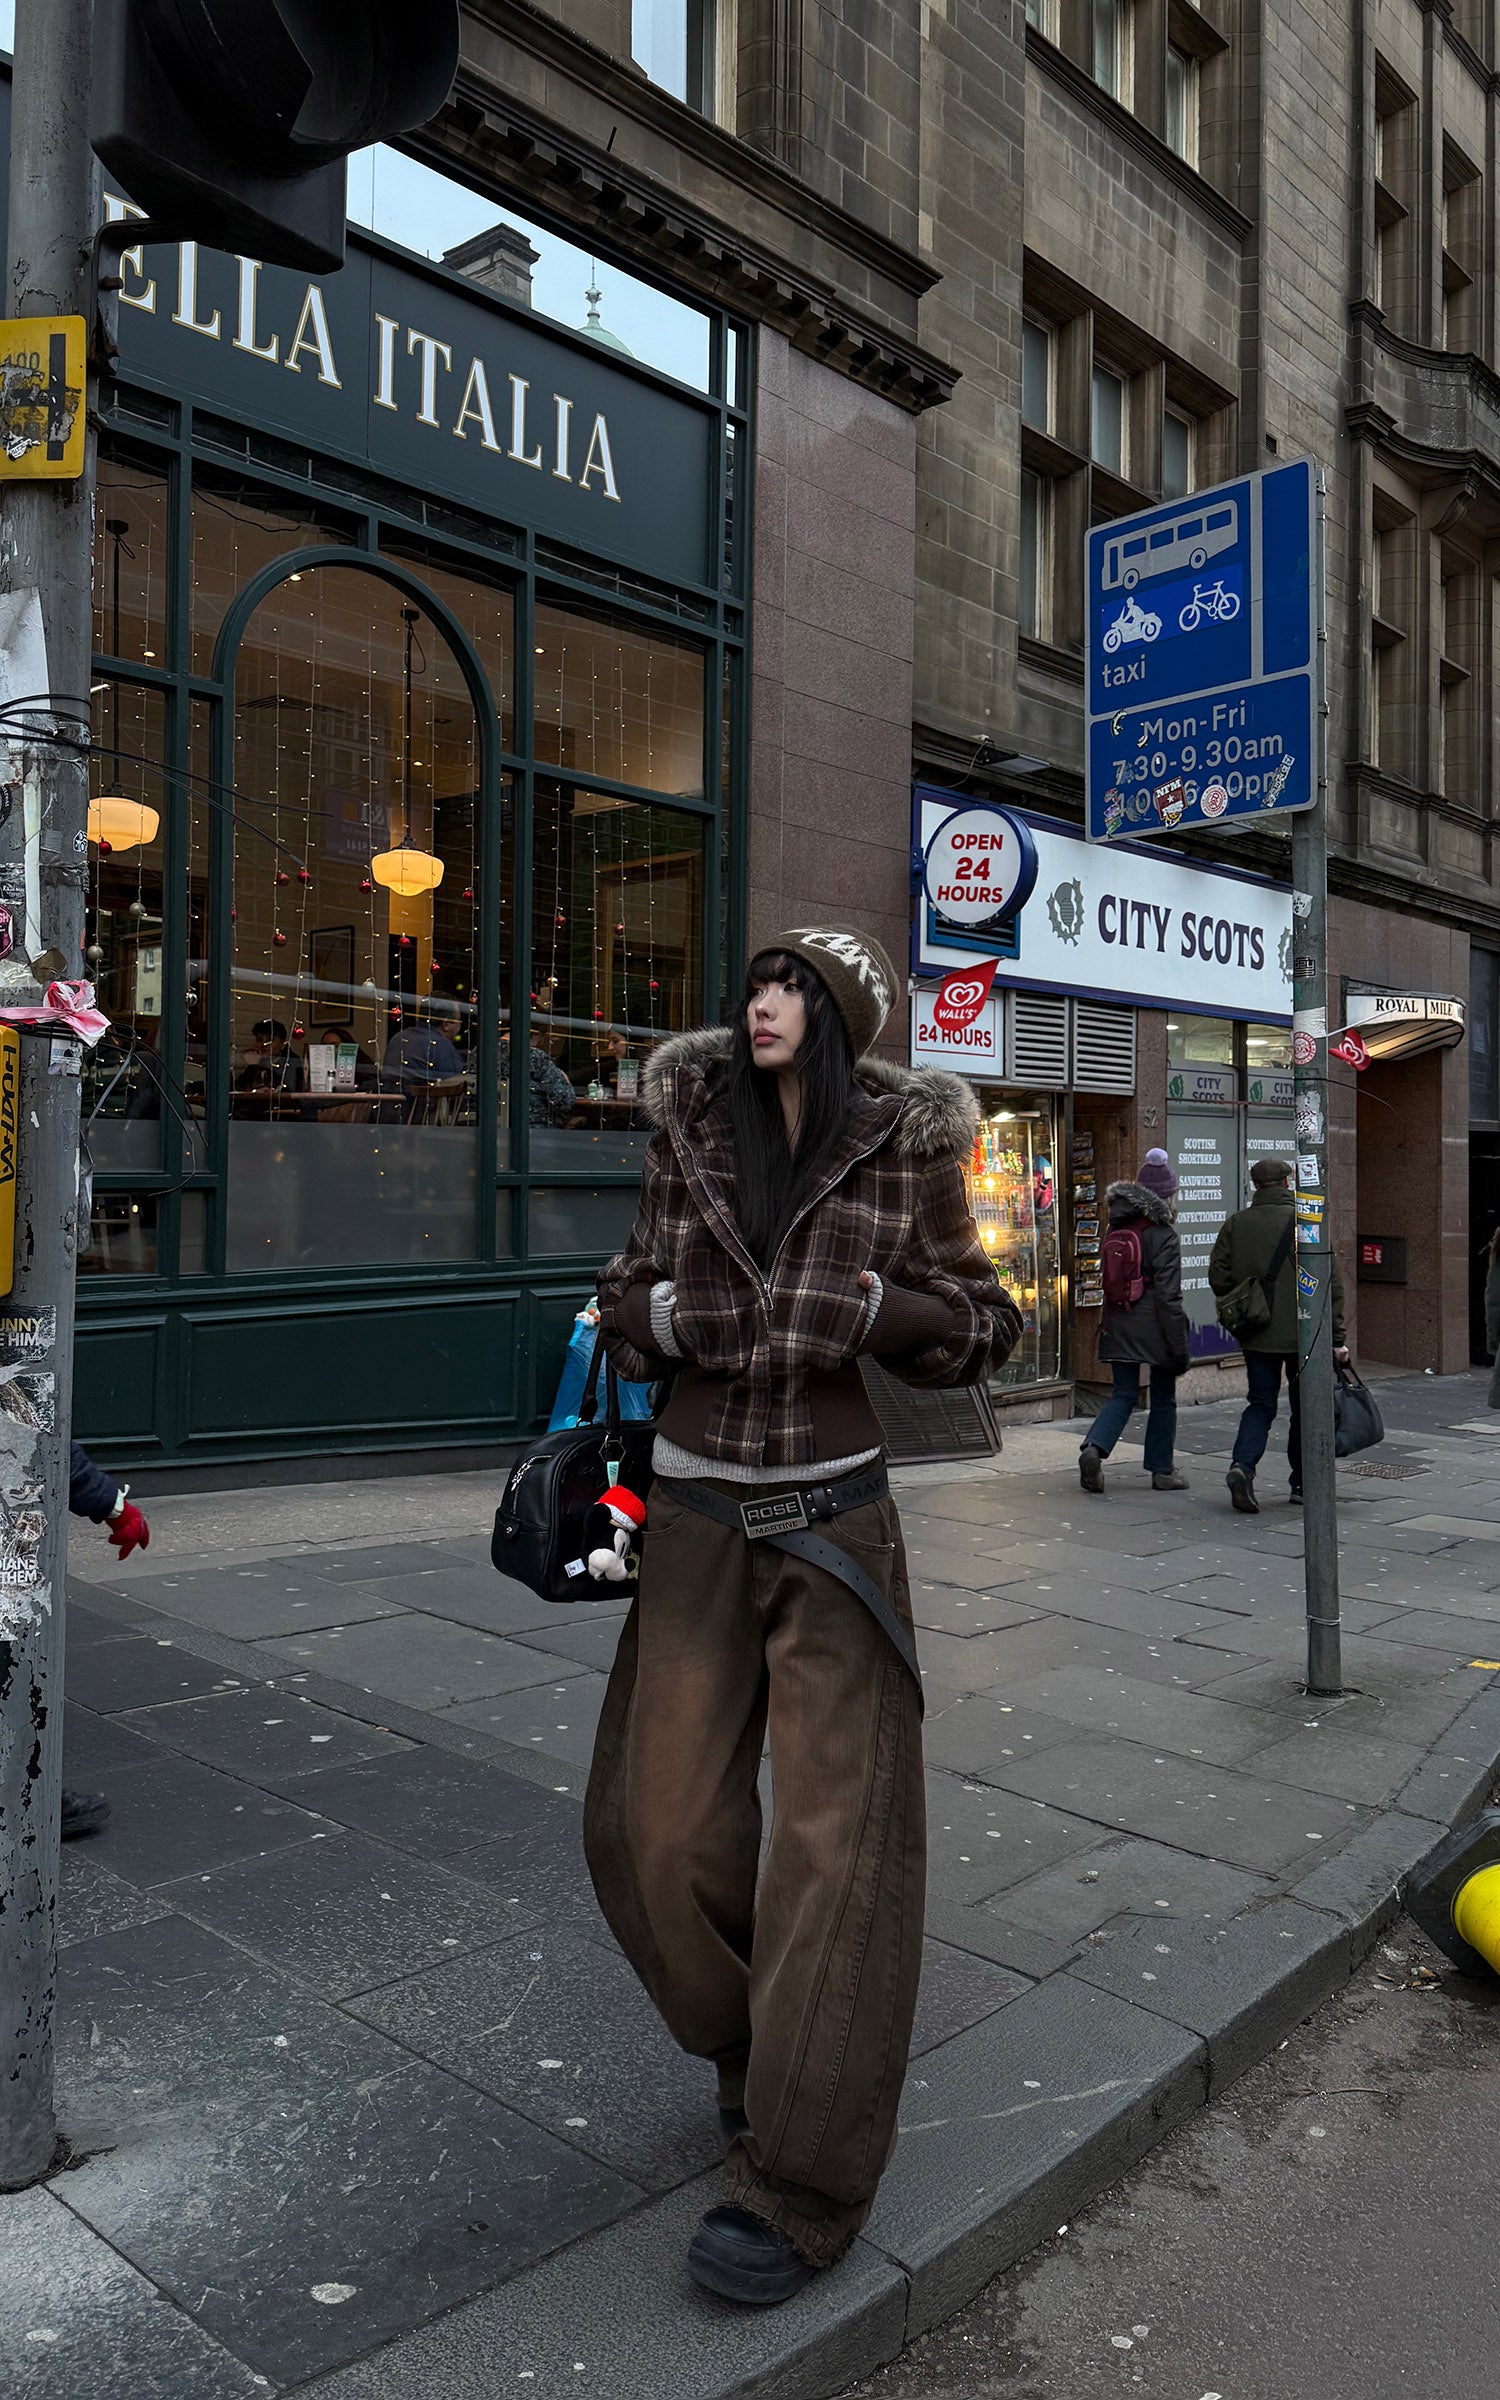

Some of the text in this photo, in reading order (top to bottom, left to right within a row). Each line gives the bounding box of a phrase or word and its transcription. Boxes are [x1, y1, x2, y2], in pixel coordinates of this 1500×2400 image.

[373, 312, 621, 503] ITALIA
[1102, 654, 1146, 688] taxi
[1144, 699, 1246, 743] Mon-Fri
[951, 834, 1004, 850] OPEN
[955, 857, 990, 880] 24
[937, 885, 1003, 903] HOURS
[1098, 894, 1265, 970] CITY SCOTS
[939, 1008, 975, 1020] WALL'S
[1375, 998, 1418, 1013] ROYAL
[1430, 1001, 1453, 1016] MILE
[919, 1024, 992, 1048] 24 HOURS
[1197, 1077, 1221, 1090] CITY
[1184, 1138, 1216, 1149] SCOTTISH
[1247, 1139, 1275, 1150] SCOTTISH
[1178, 1153, 1222, 1164] SHORTBREAD
[1179, 1175, 1221, 1187] SANDWICHES
[1184, 1189, 1222, 1201] BAGUETTES
[1177, 1211, 1227, 1223] ONFECTIONERY
[1180, 1234, 1192, 1246] ICE
[8, 1332, 39, 1346] HIM
[747, 1501, 799, 1522] ROSE
[754, 1520, 799, 1535] MARTINE
